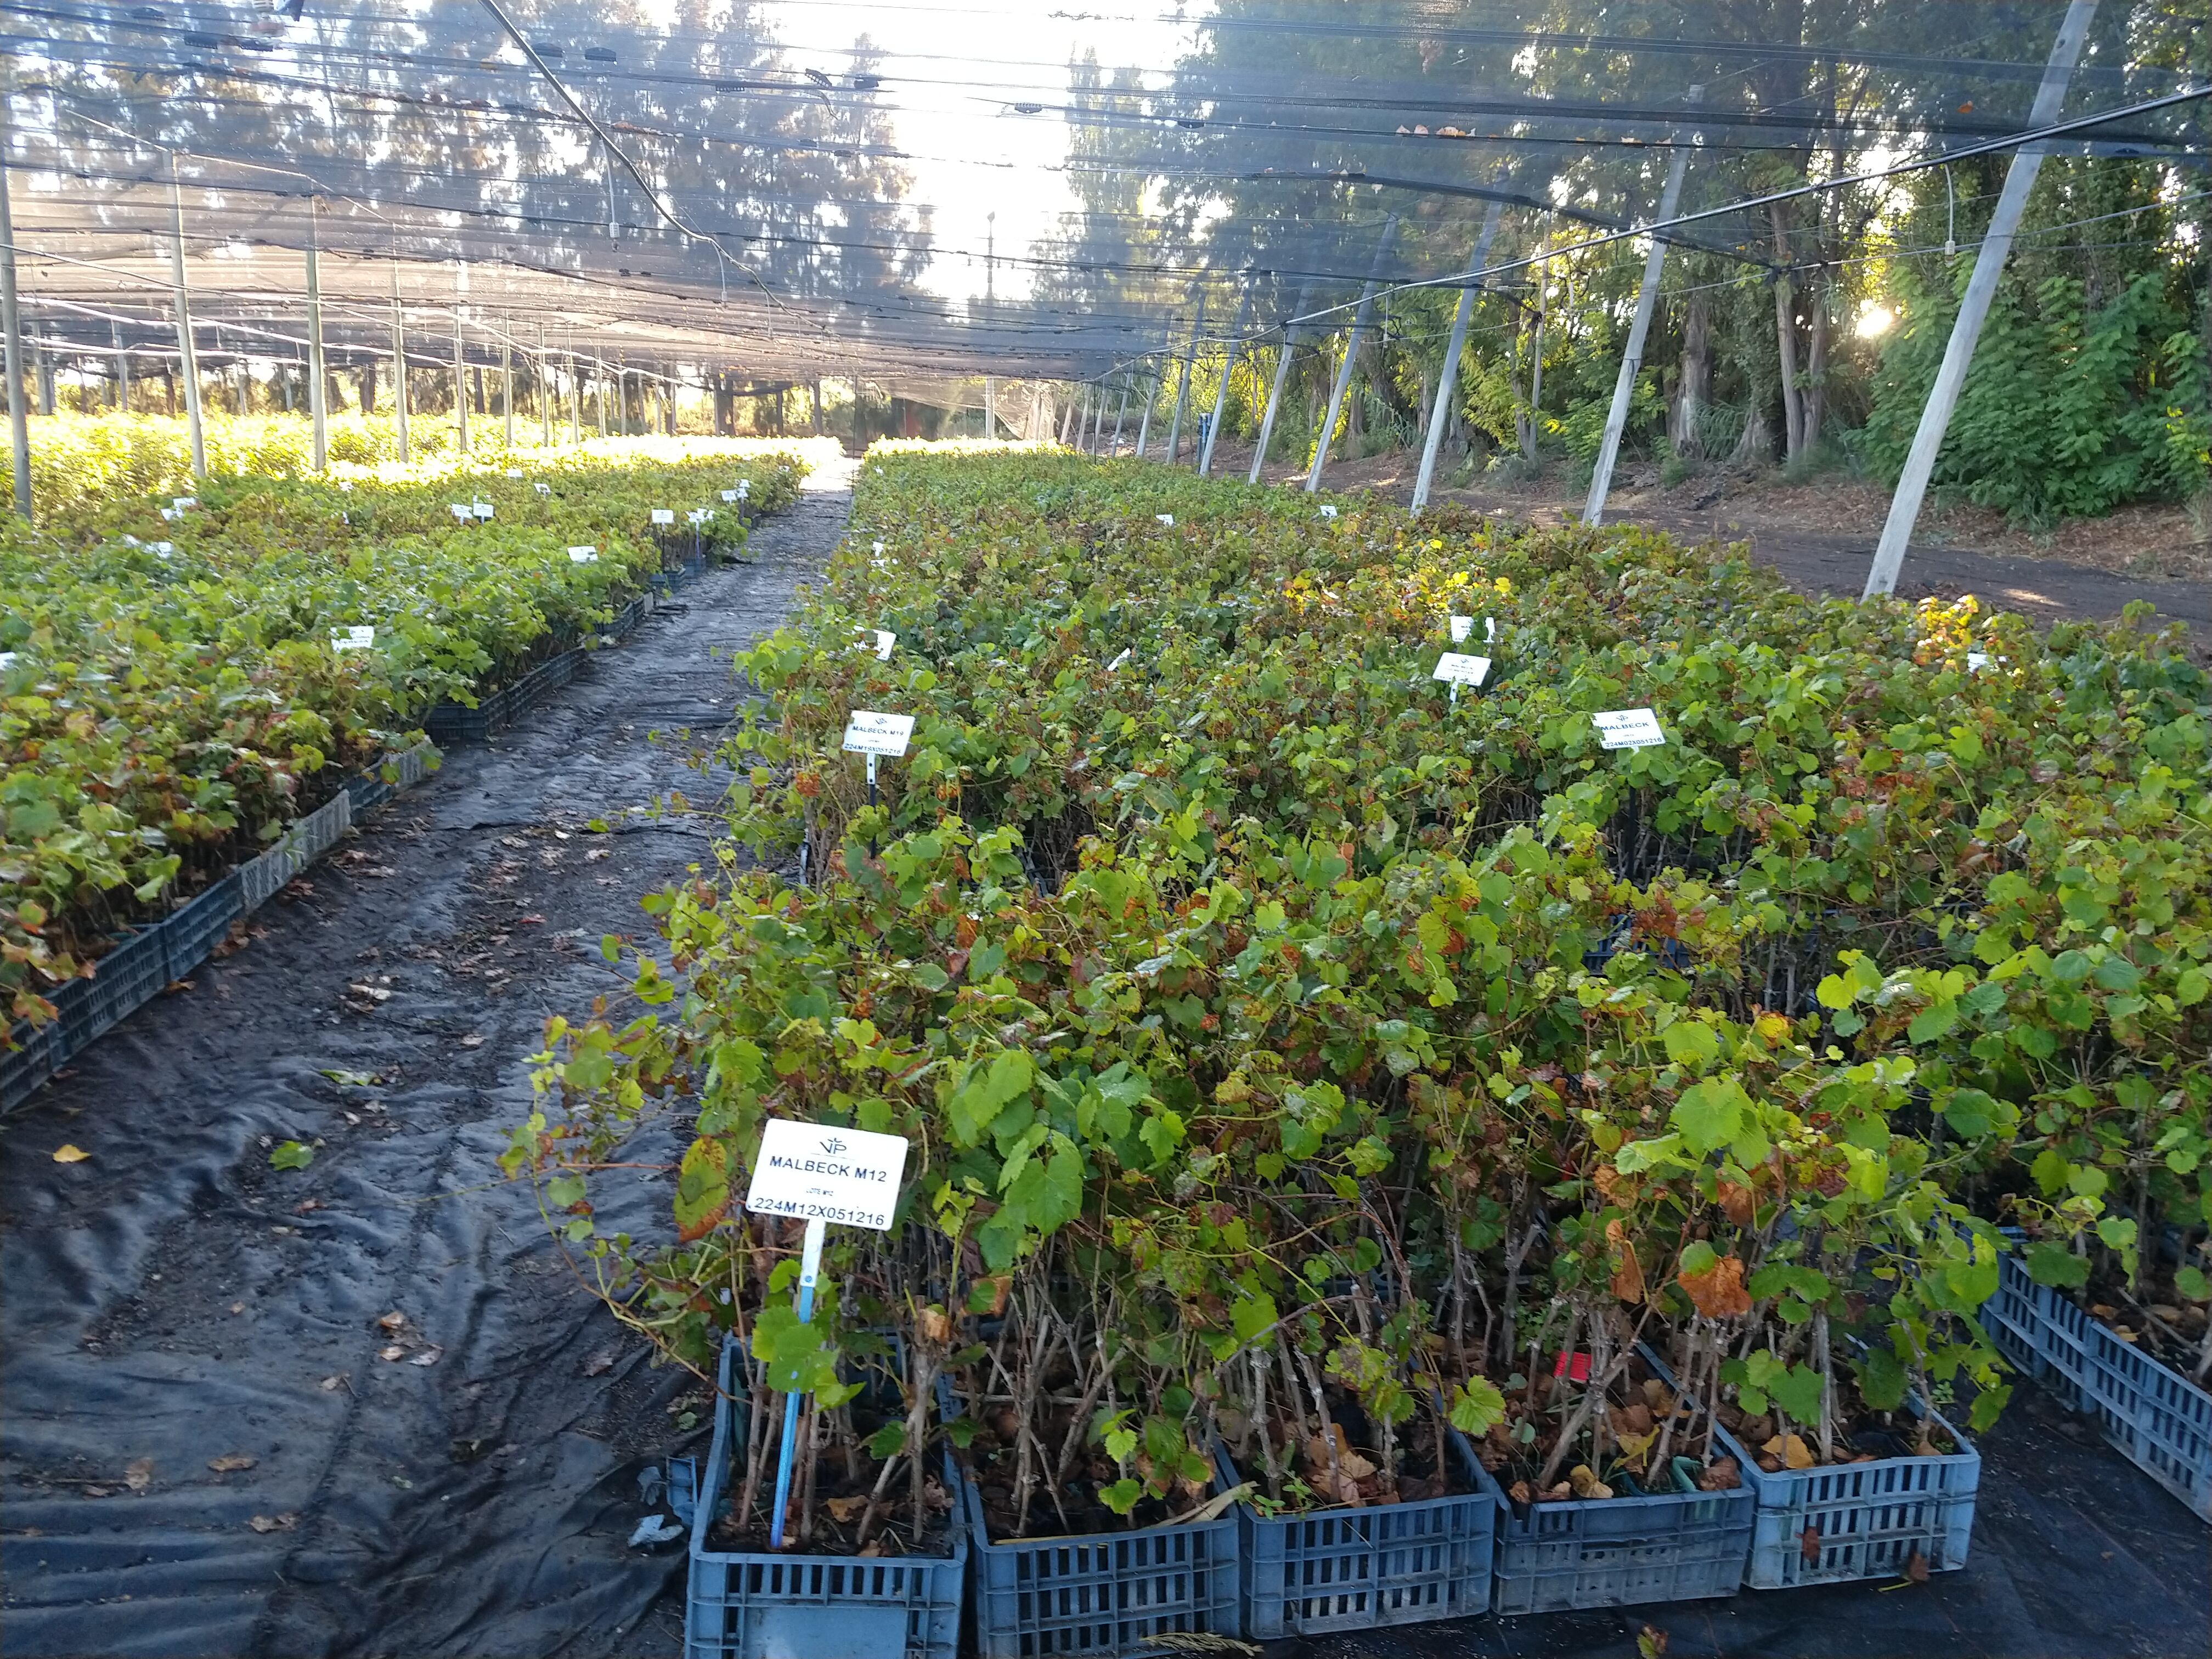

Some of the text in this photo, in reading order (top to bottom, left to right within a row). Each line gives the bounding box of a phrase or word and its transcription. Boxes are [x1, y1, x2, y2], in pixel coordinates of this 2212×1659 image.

[852, 725, 887, 735] MALBECK
[1601, 722, 1649, 731] MALBECK
[769, 1155, 887, 1182] MALBECK M12
[754, 1197, 885, 1226] 224M12X051216
